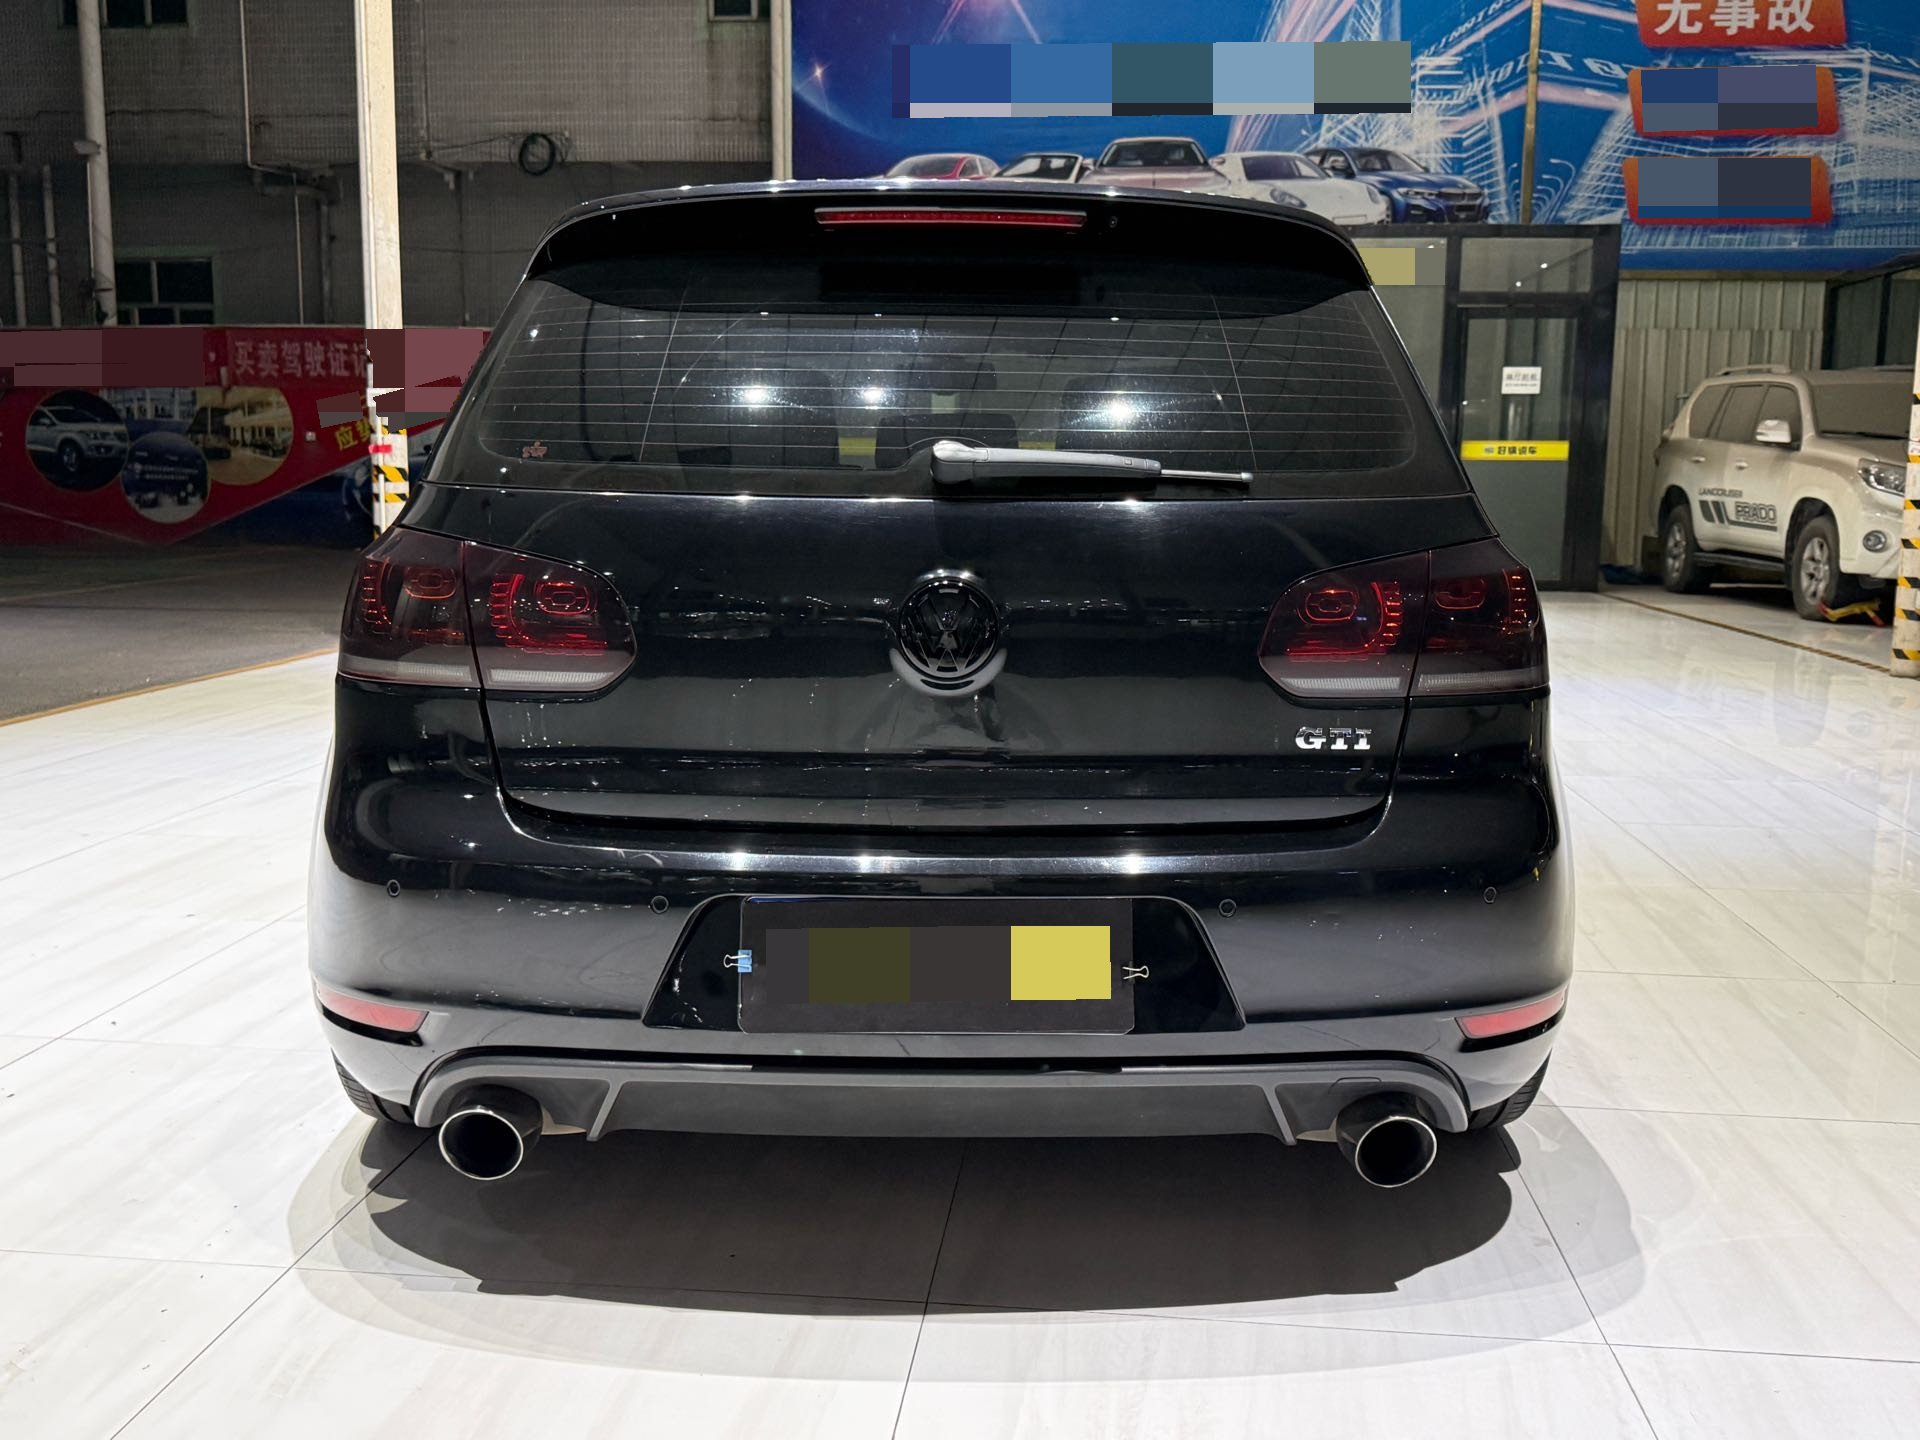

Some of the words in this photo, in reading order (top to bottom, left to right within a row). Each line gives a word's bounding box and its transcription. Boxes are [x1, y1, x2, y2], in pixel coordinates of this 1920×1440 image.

[1654, 0, 1815, 36] 无事故
[1735, 501, 1777, 524] PRADO
[1295, 726, 1372, 750] GTI
